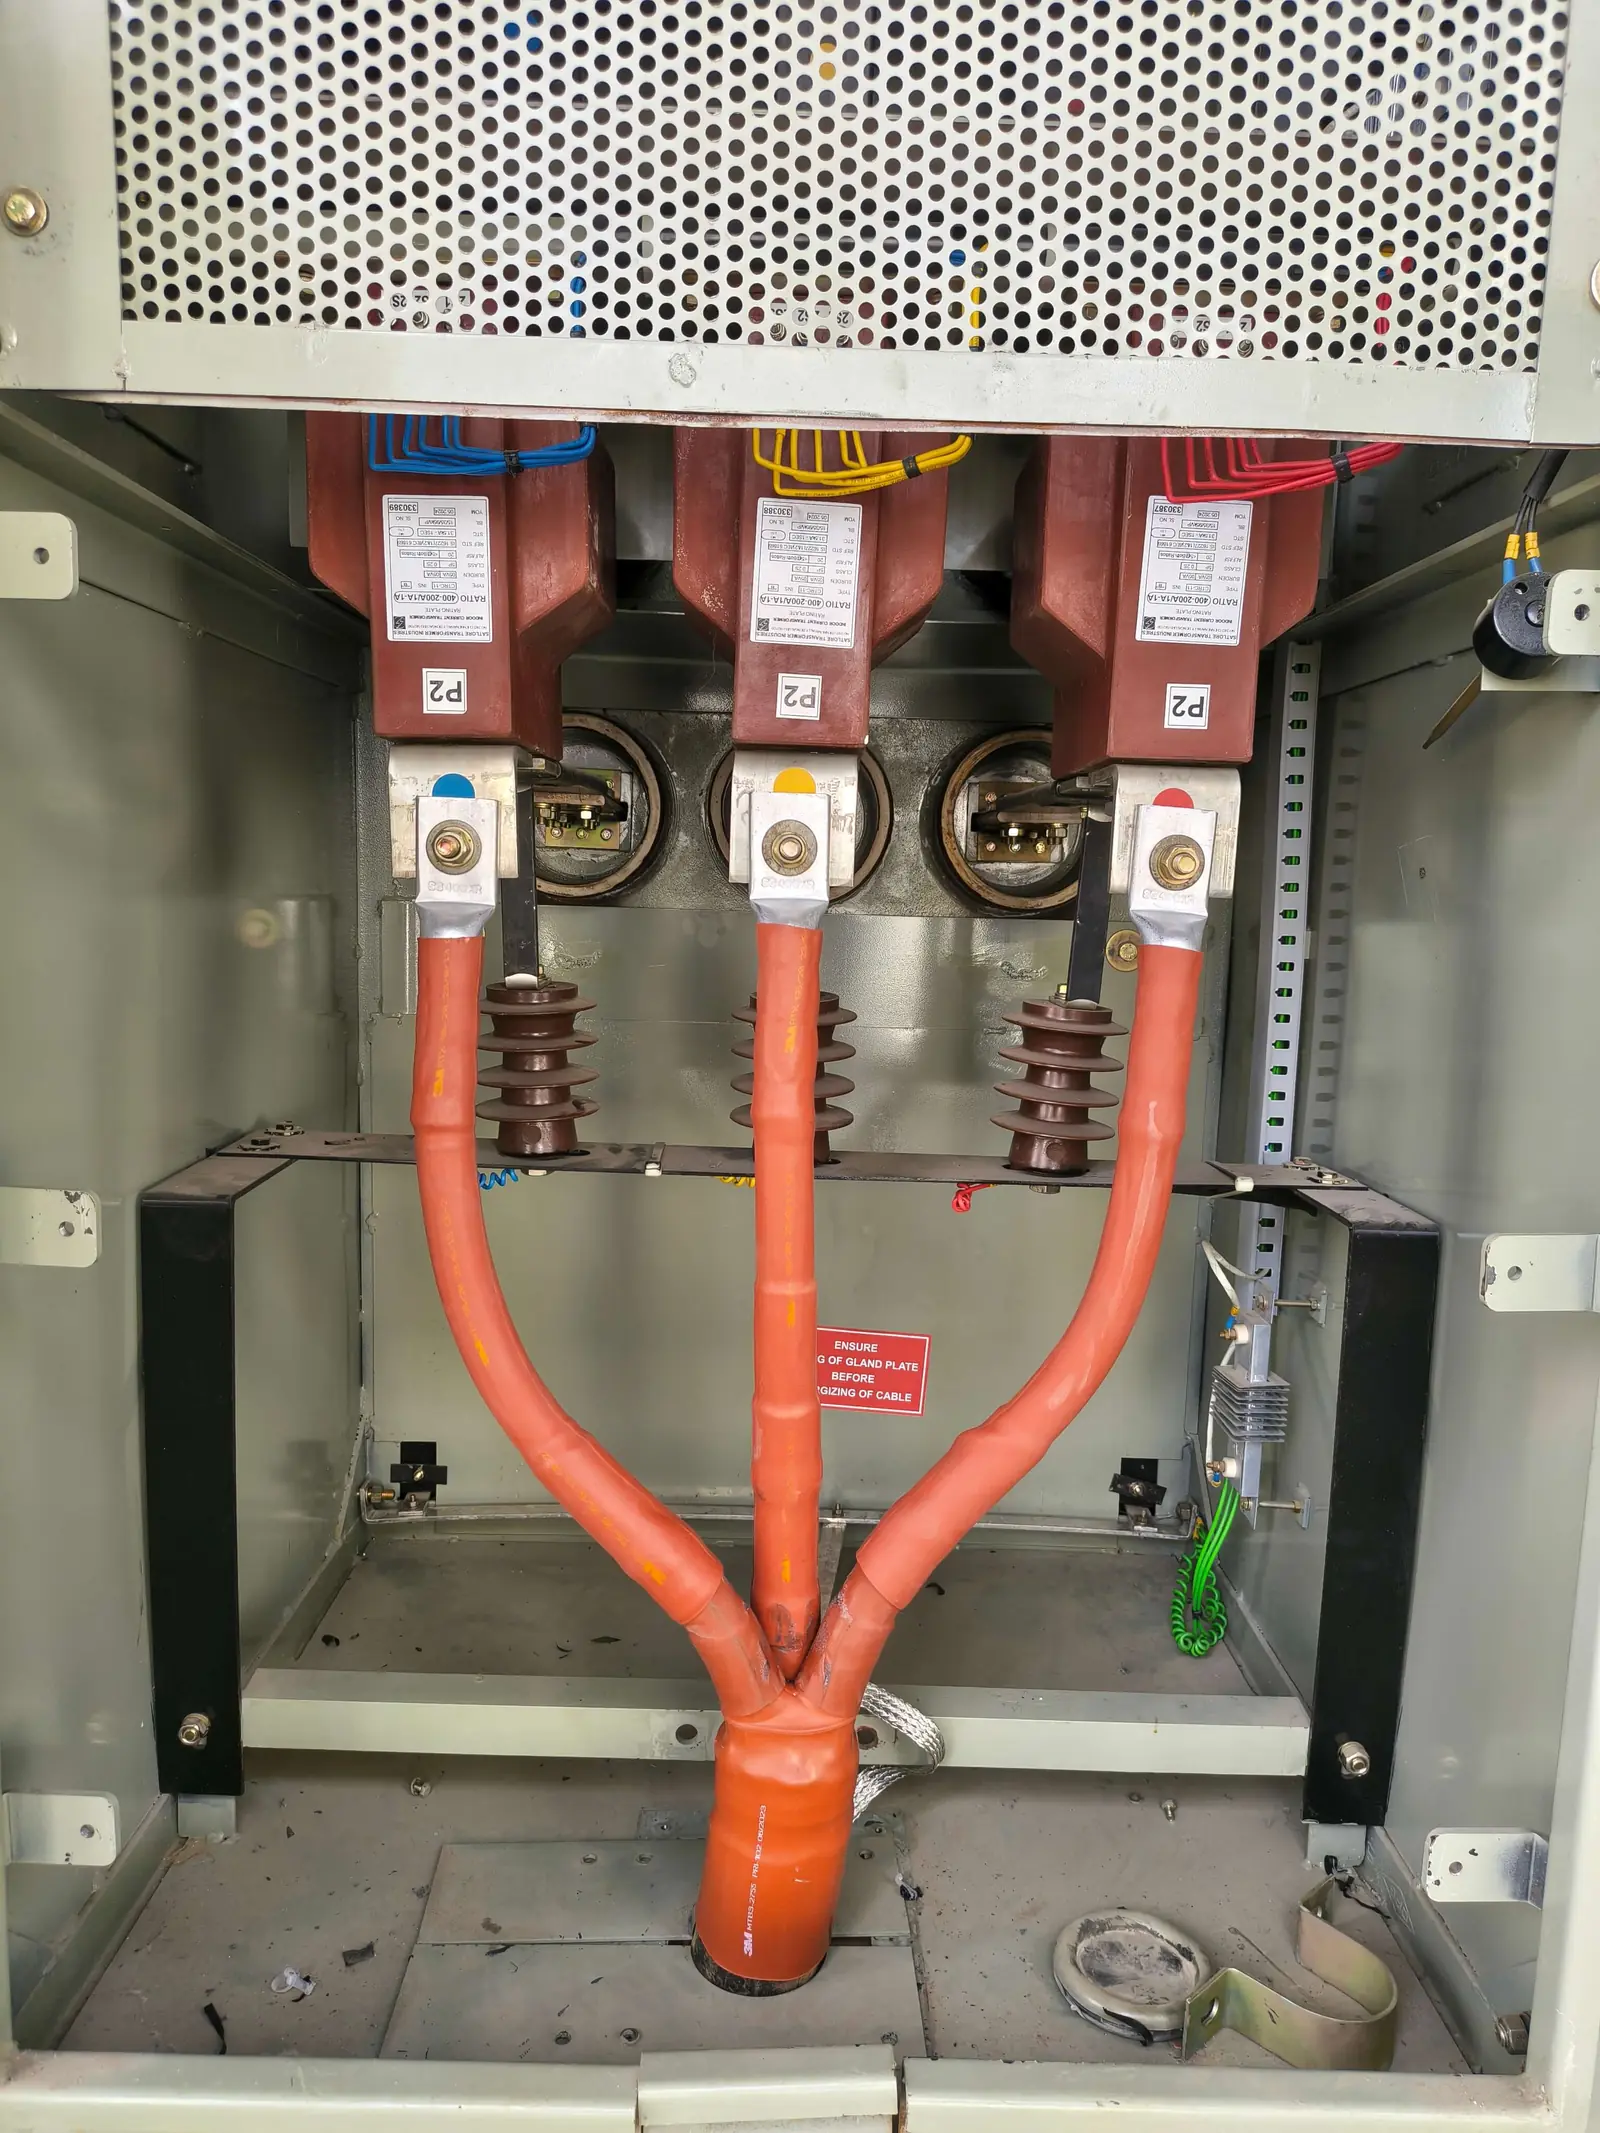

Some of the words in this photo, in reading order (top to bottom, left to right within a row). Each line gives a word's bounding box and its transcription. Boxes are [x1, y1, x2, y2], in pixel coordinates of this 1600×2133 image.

[764, 507, 790, 515] 330388
[1154, 505, 1182, 513] 330387
[760, 595, 821, 606] 400-200A/1A-1A
[1148, 594, 1208, 603] 400-200A/1A-1A
[1213, 598, 1238, 606] RATIO
[826, 601, 850, 609] RATIO
[429, 680, 462, 702] P2
[784, 685, 816, 708] P2
[1172, 696, 1204, 717] P2
[834, 1341, 878, 1352] ENSURE
[828, 1356, 842, 1365] OF
[846, 1358, 882, 1368] GLAND
[885, 1361, 918, 1371] PLATE
[832, 1372, 875, 1383] BEFORE
[859, 1390, 873, 1398] OF
[876, 1391, 912, 1402] CABLE
[743, 1931, 753, 1956] 3M
